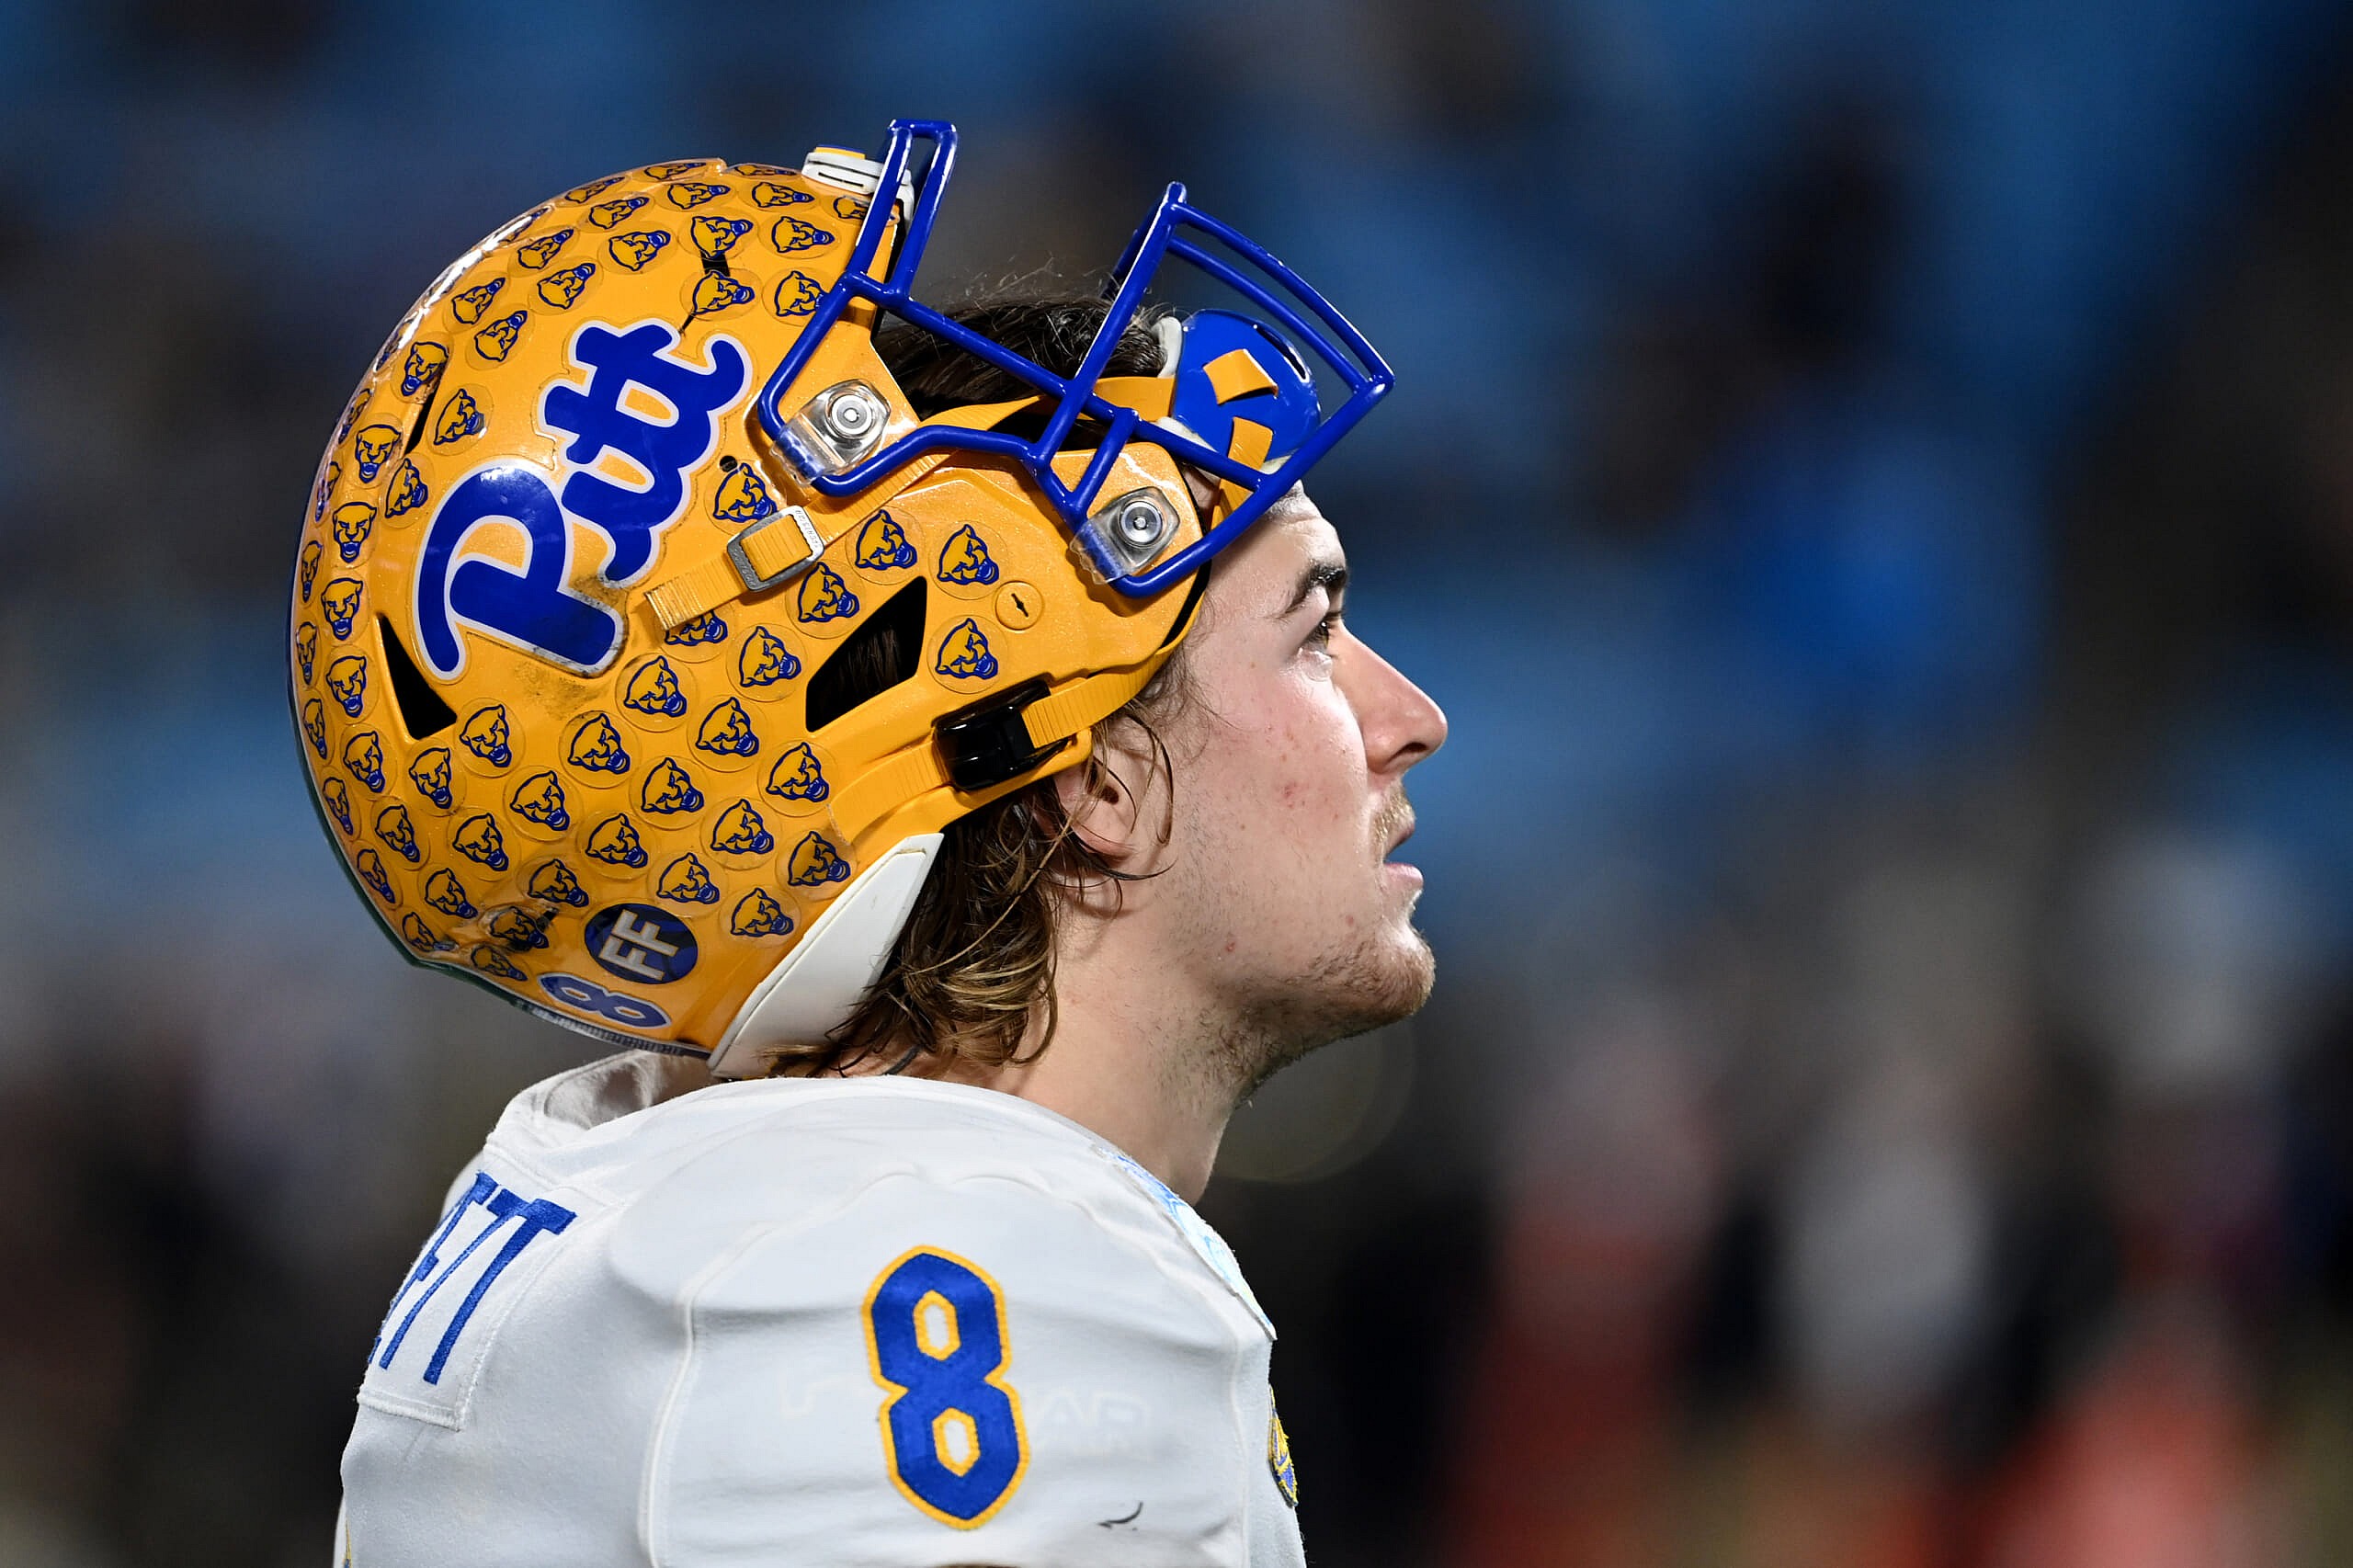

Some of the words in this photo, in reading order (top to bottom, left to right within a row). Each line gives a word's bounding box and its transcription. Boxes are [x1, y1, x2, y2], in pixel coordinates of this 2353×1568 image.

[415, 319, 753, 680] Pitt
[537, 972, 673, 1028] 8
[598, 909, 679, 982] FF
[861, 1244, 1030, 1530] 8
